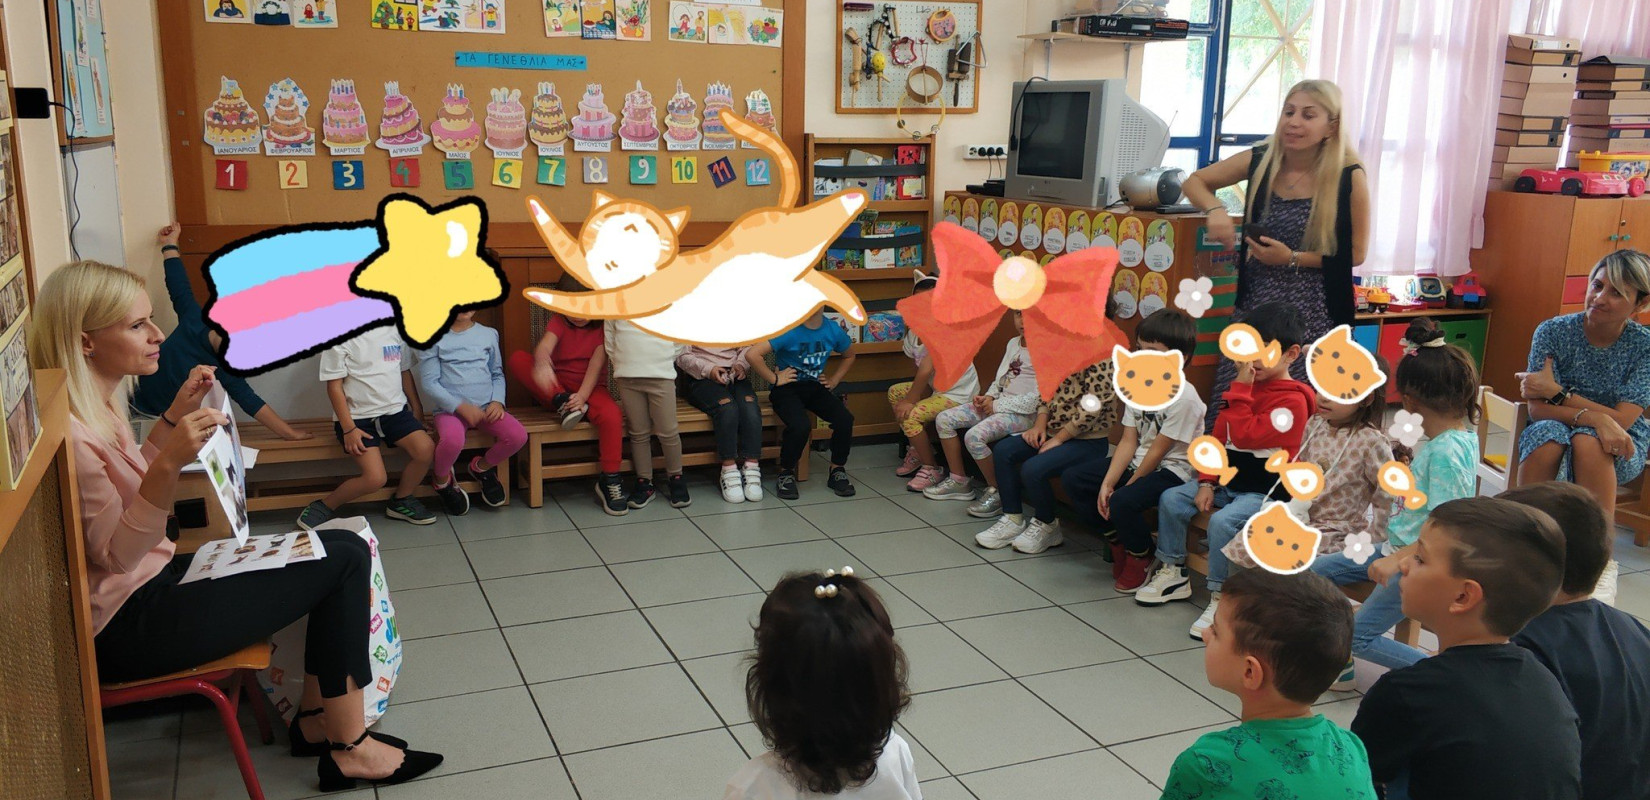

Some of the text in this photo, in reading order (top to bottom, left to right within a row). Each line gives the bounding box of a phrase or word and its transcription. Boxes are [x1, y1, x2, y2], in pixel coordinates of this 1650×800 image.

[463, 53, 577, 67] ΤΑ ΓΕΝΕΘΛΙΑ ΜΑΣ
[392, 146, 419, 154] ΑΠΡΙΛΙΟΣ
[225, 163, 235, 187] 1
[285, 162, 300, 186] 2
[342, 163, 356, 187] 3
[396, 160, 410, 185] 4
[452, 164, 466, 187] 5
[499, 161, 513, 185] 6
[544, 159, 560, 184] 7
[588, 156, 603, 183] 8
[638, 158, 650, 179] 9
[674, 160, 694, 181] 10
[712, 160, 732, 182] 11
[748, 160, 768, 182] 12
